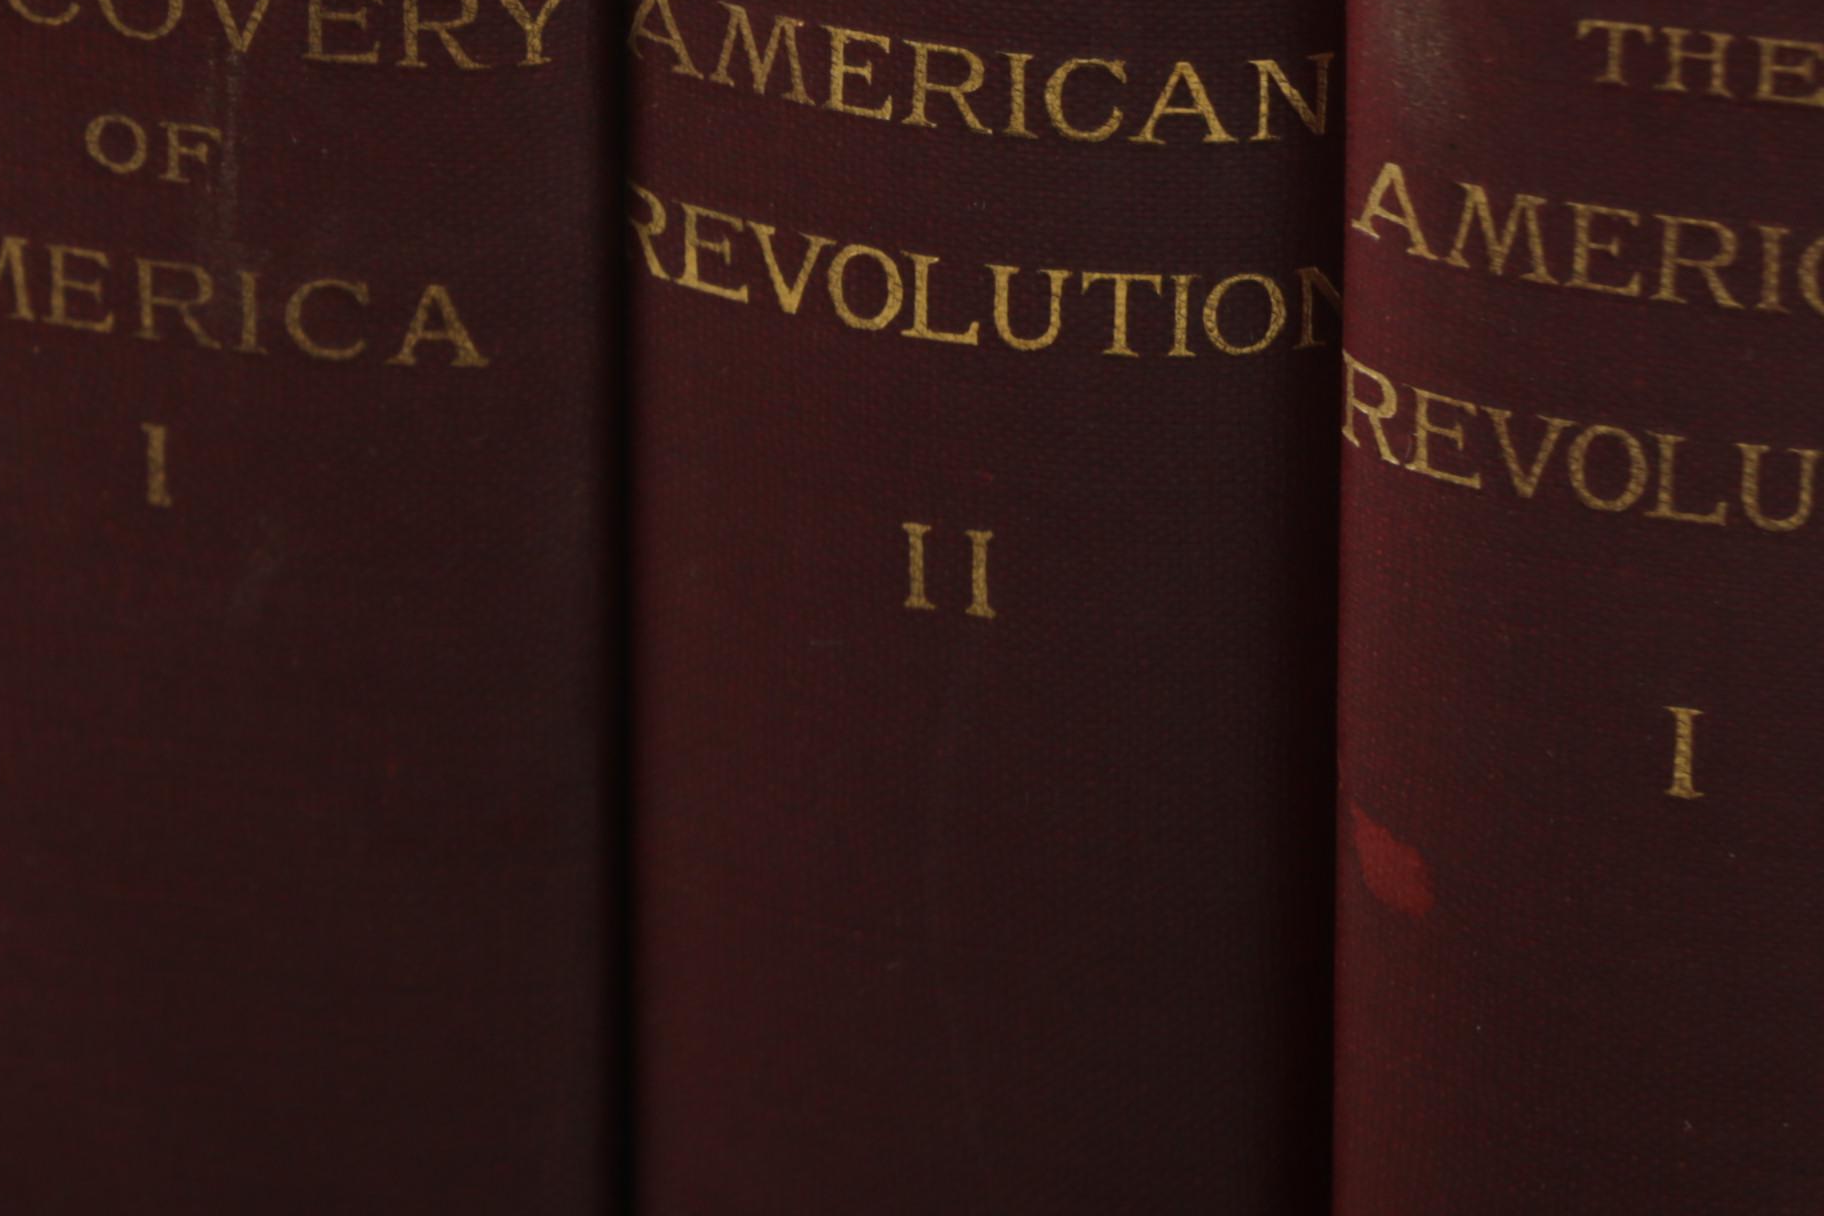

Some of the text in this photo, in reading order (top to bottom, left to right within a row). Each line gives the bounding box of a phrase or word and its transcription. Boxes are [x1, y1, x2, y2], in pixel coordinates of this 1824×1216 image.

[1576, 18, 1824, 107] THE
[84, 114, 223, 182] OF
[139, 421, 174, 508] I
[1341, 352, 1824, 532] REVOLU
[902, 521, 996, 620] II
[1663, 705, 1704, 800] I
